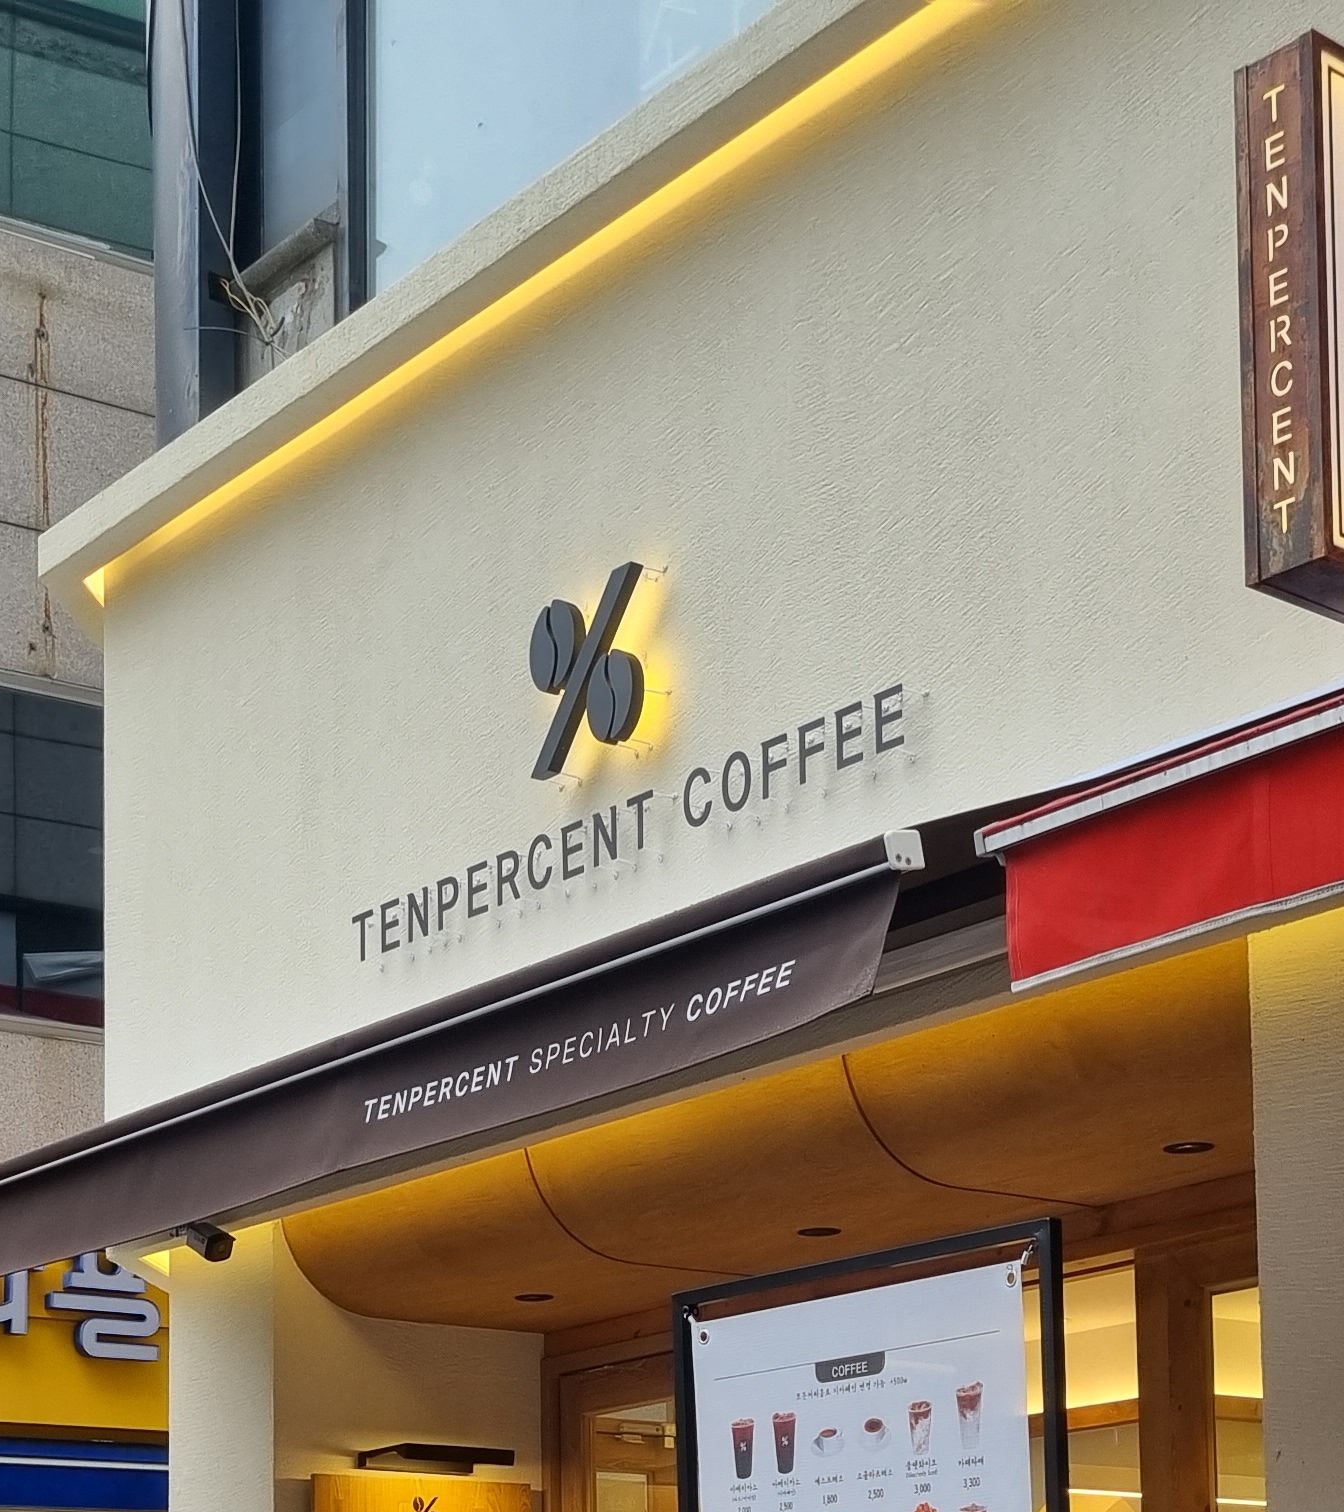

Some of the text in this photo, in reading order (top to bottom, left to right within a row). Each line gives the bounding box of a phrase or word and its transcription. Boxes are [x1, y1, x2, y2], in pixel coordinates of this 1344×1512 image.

[1262, 84, 1296, 534] TENPERCENT
[352, 683, 904, 963] TENPERCENT COFFEE
[363, 960, 797, 1124] TENPERCENT SPECIALTY COFFEE
[831, 1361, 869, 1378] COFFEE
[867, 1489, 885, 1501] 2,500
[914, 1483, 931, 1495] 3,000
